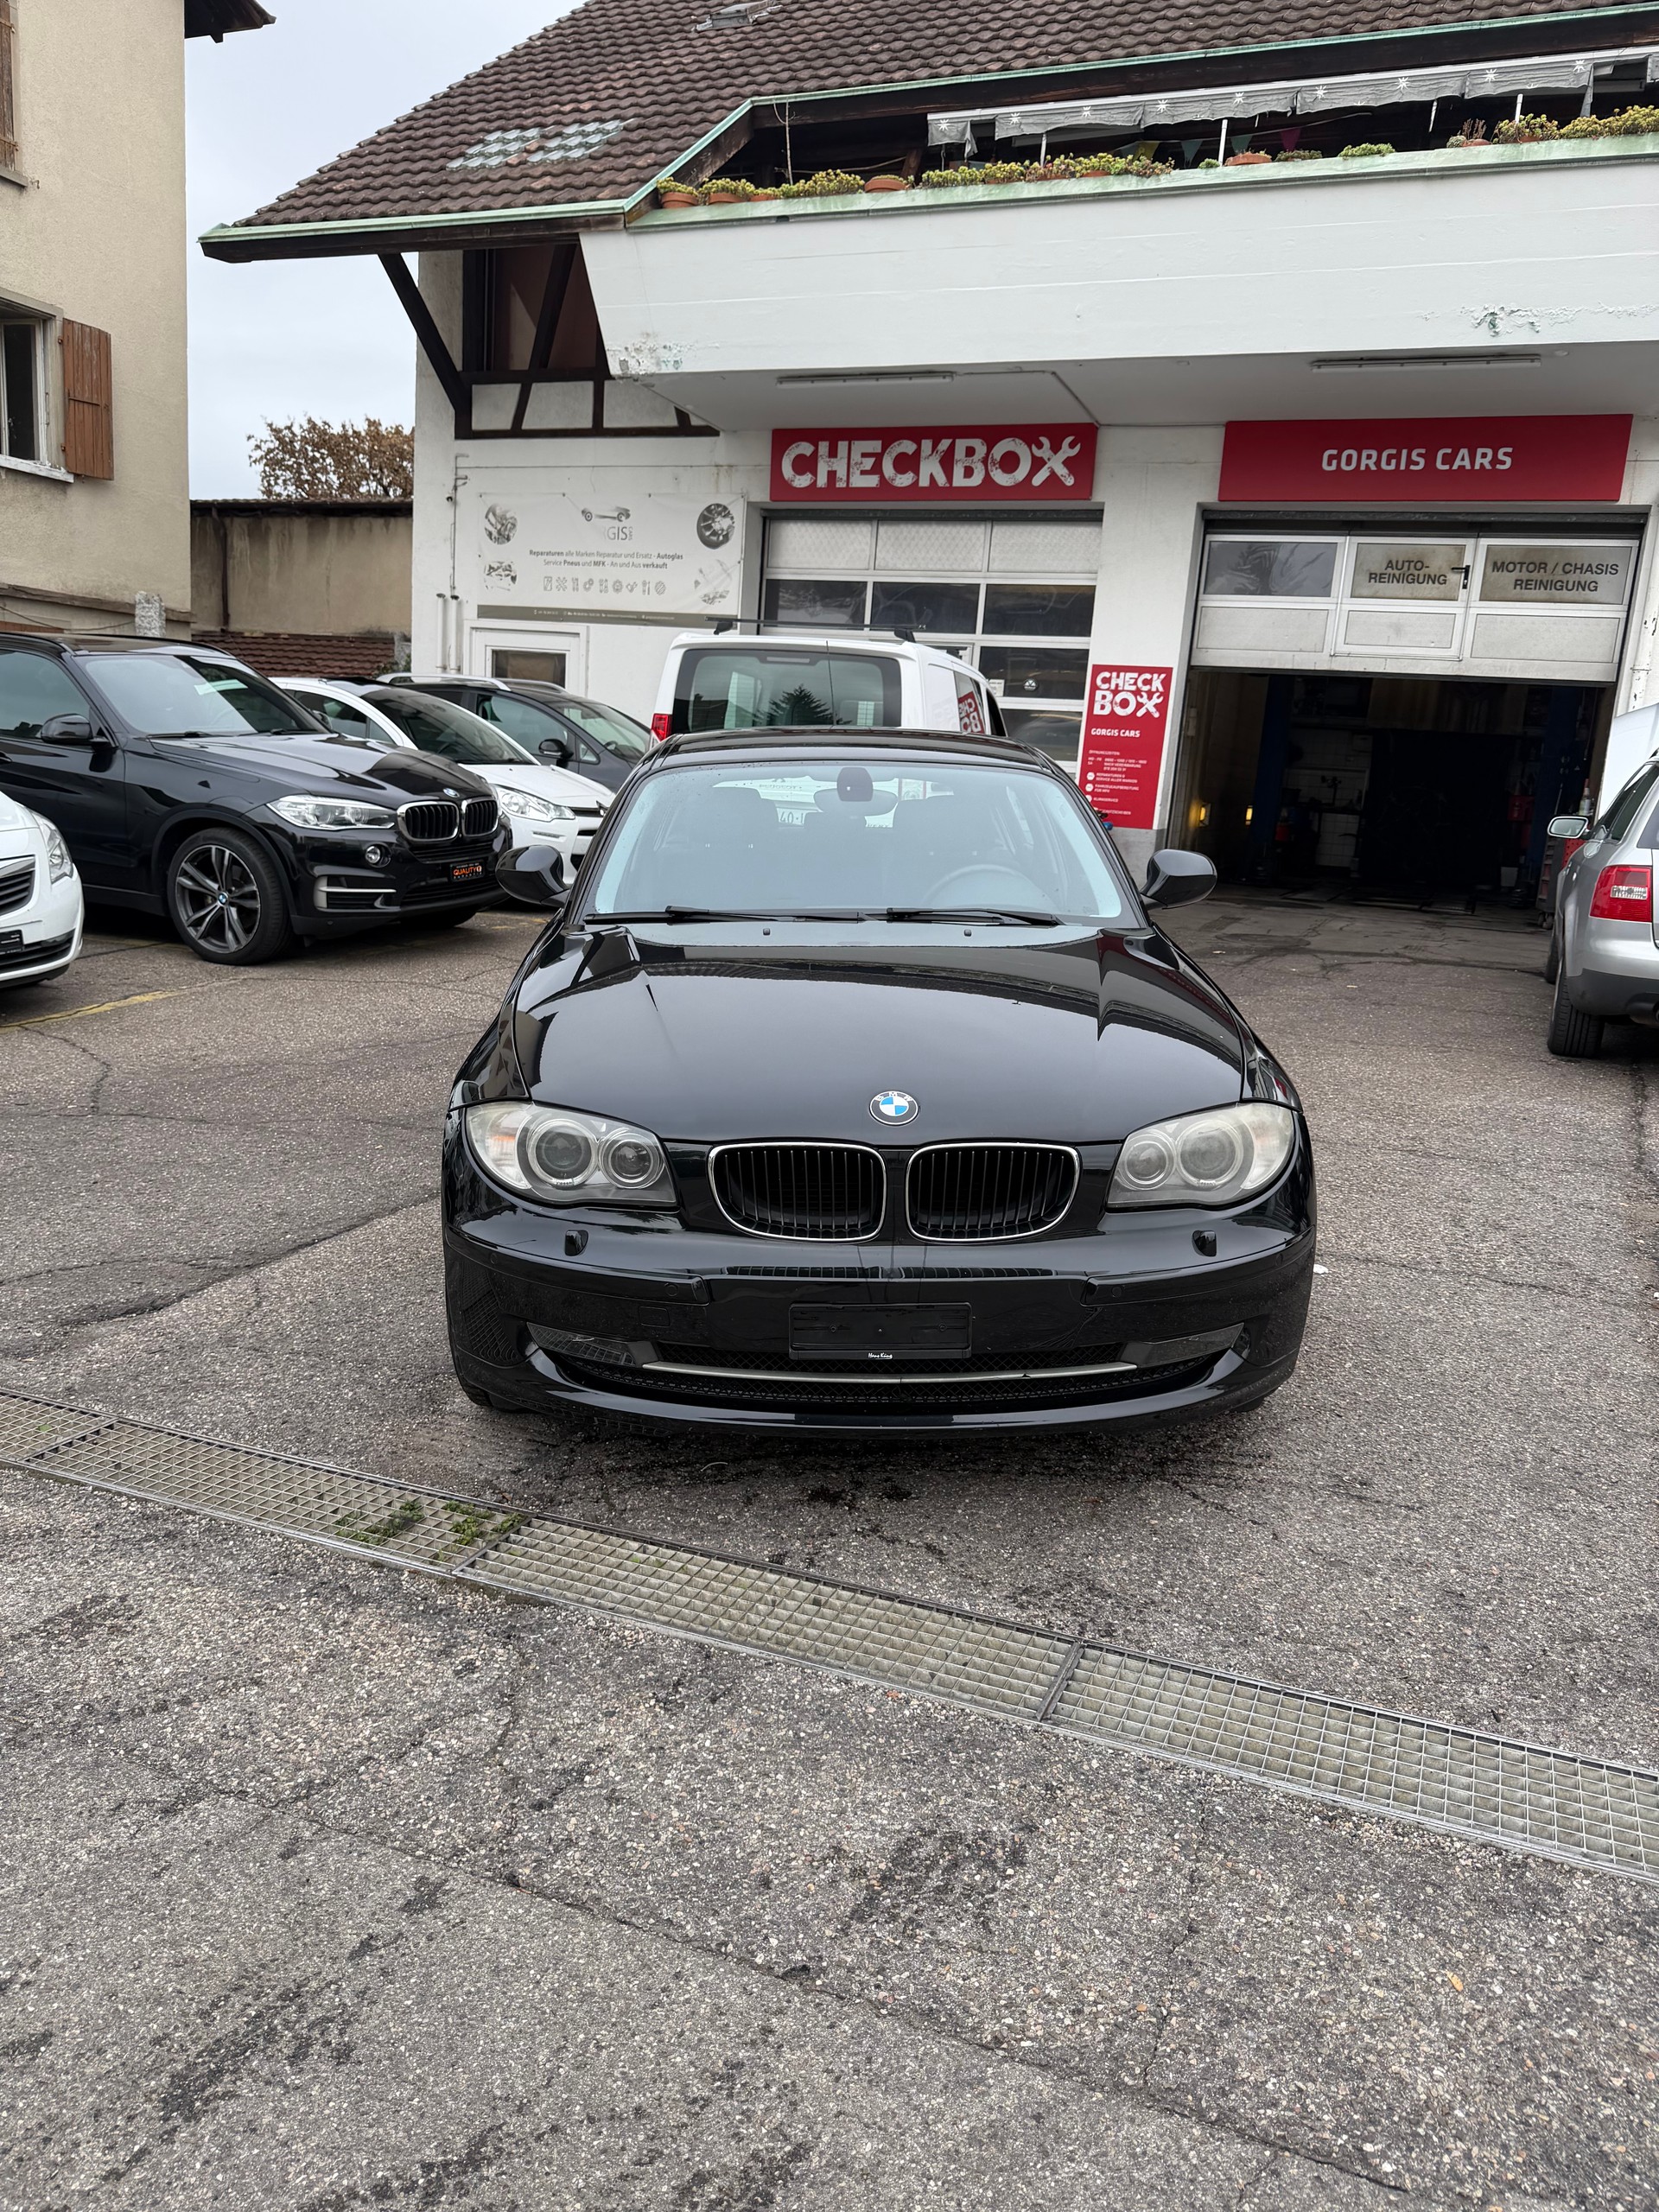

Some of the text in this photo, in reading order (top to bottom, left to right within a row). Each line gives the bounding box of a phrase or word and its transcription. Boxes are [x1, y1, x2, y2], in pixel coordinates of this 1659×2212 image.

[782, 436, 1081, 488] CHECKBOX
[1322, 447, 1514, 471] GORGIS CARS
[1384, 559, 1430, 572] AUTO-
[1491, 561, 1547, 575] MOTOR
[1561, 562, 1619, 575] CHASIS
[1368, 572, 1447, 586] REINIGUNG
[1513, 579, 1599, 593] REINIGUNG
[1096, 671, 1166, 692] CHECK
[1093, 690, 1164, 718] BOX
[1090, 728, 1141, 738] GORGIS CARS
[874, 1092, 913, 1102] BMW
